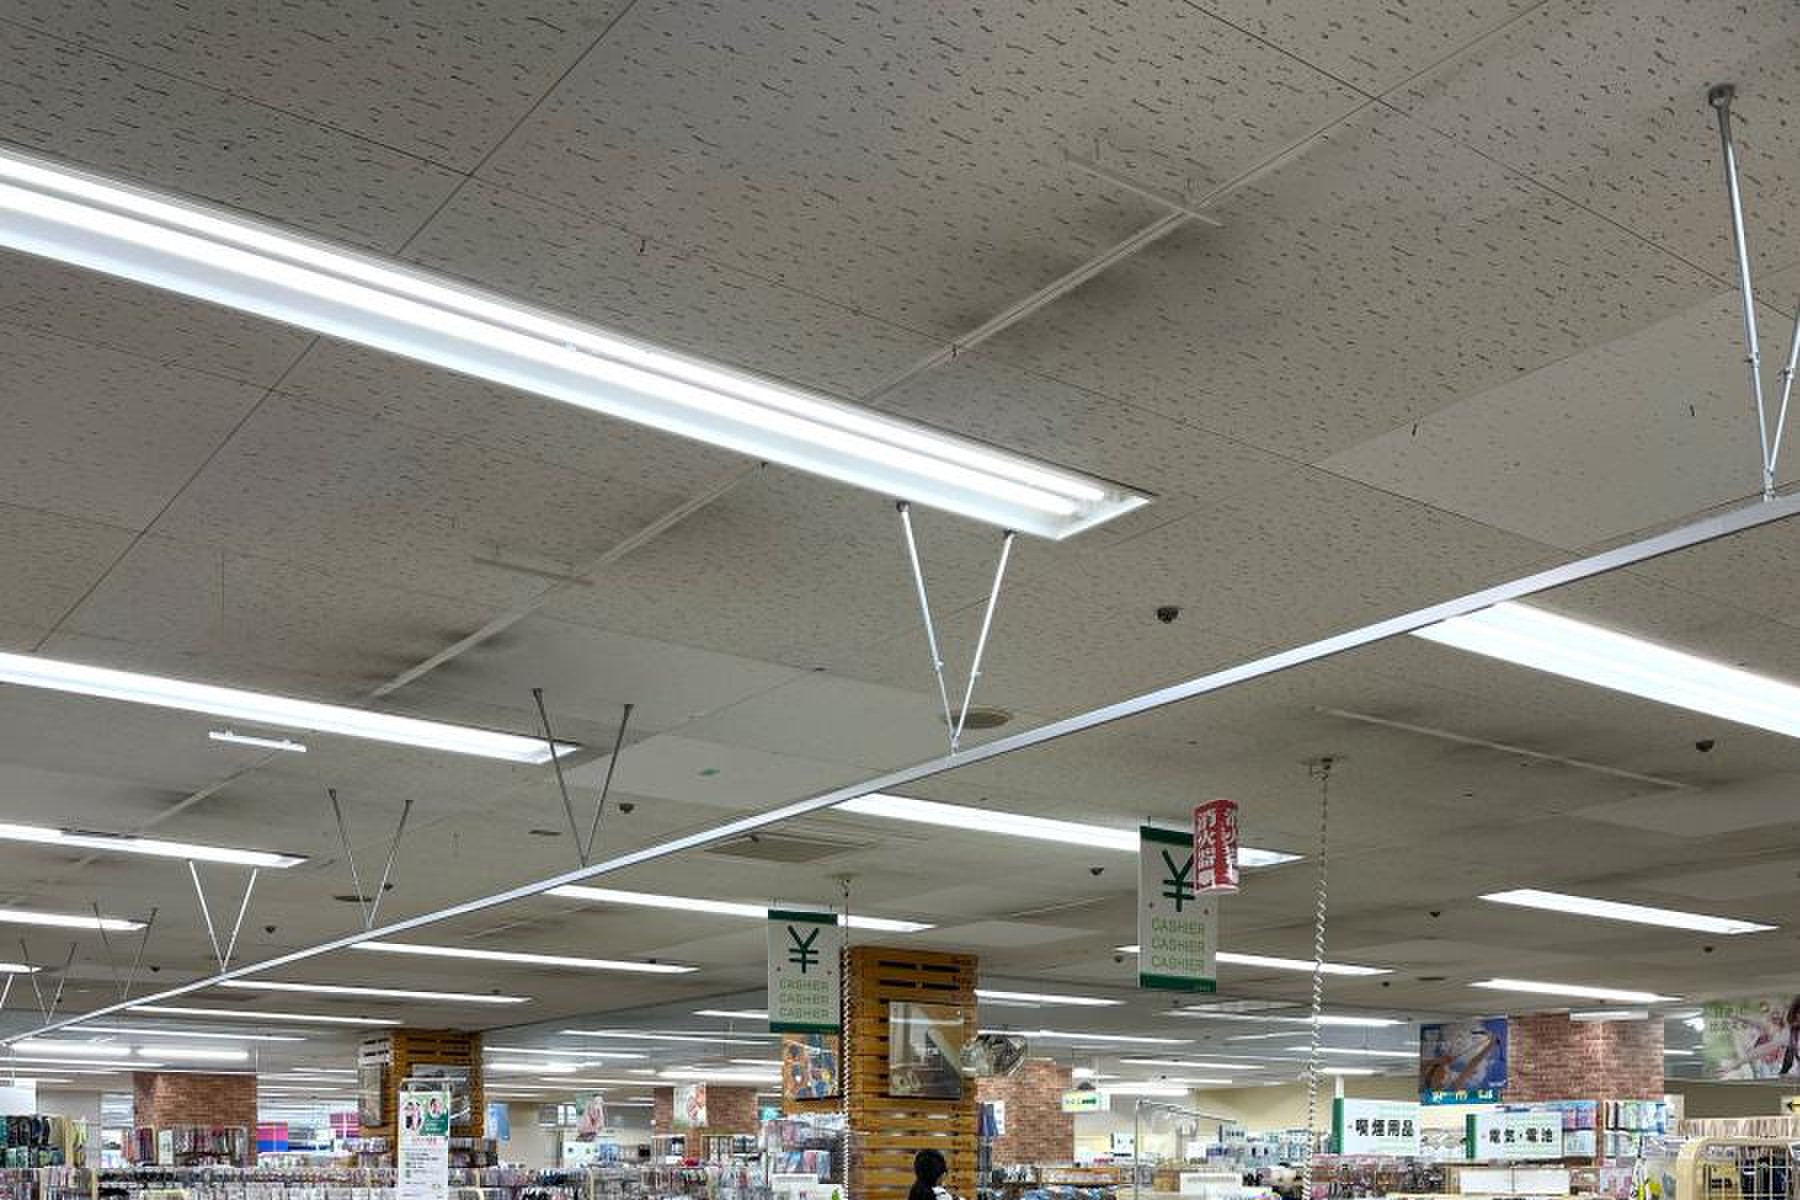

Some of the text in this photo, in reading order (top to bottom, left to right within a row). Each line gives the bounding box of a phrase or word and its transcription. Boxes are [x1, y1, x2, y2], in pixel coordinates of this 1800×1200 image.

[1152, 917, 1205, 937] CASHIER
[1152, 936, 1205, 954] CASHIER
[1152, 953, 1205, 972] CASHIER
[780, 979, 830, 992] CASHIER
[780, 992, 830, 1005] CASHIER
[780, 1006, 830, 1019] CASHIER
[1355, 1118, 1415, 1137] 喫煙用品
